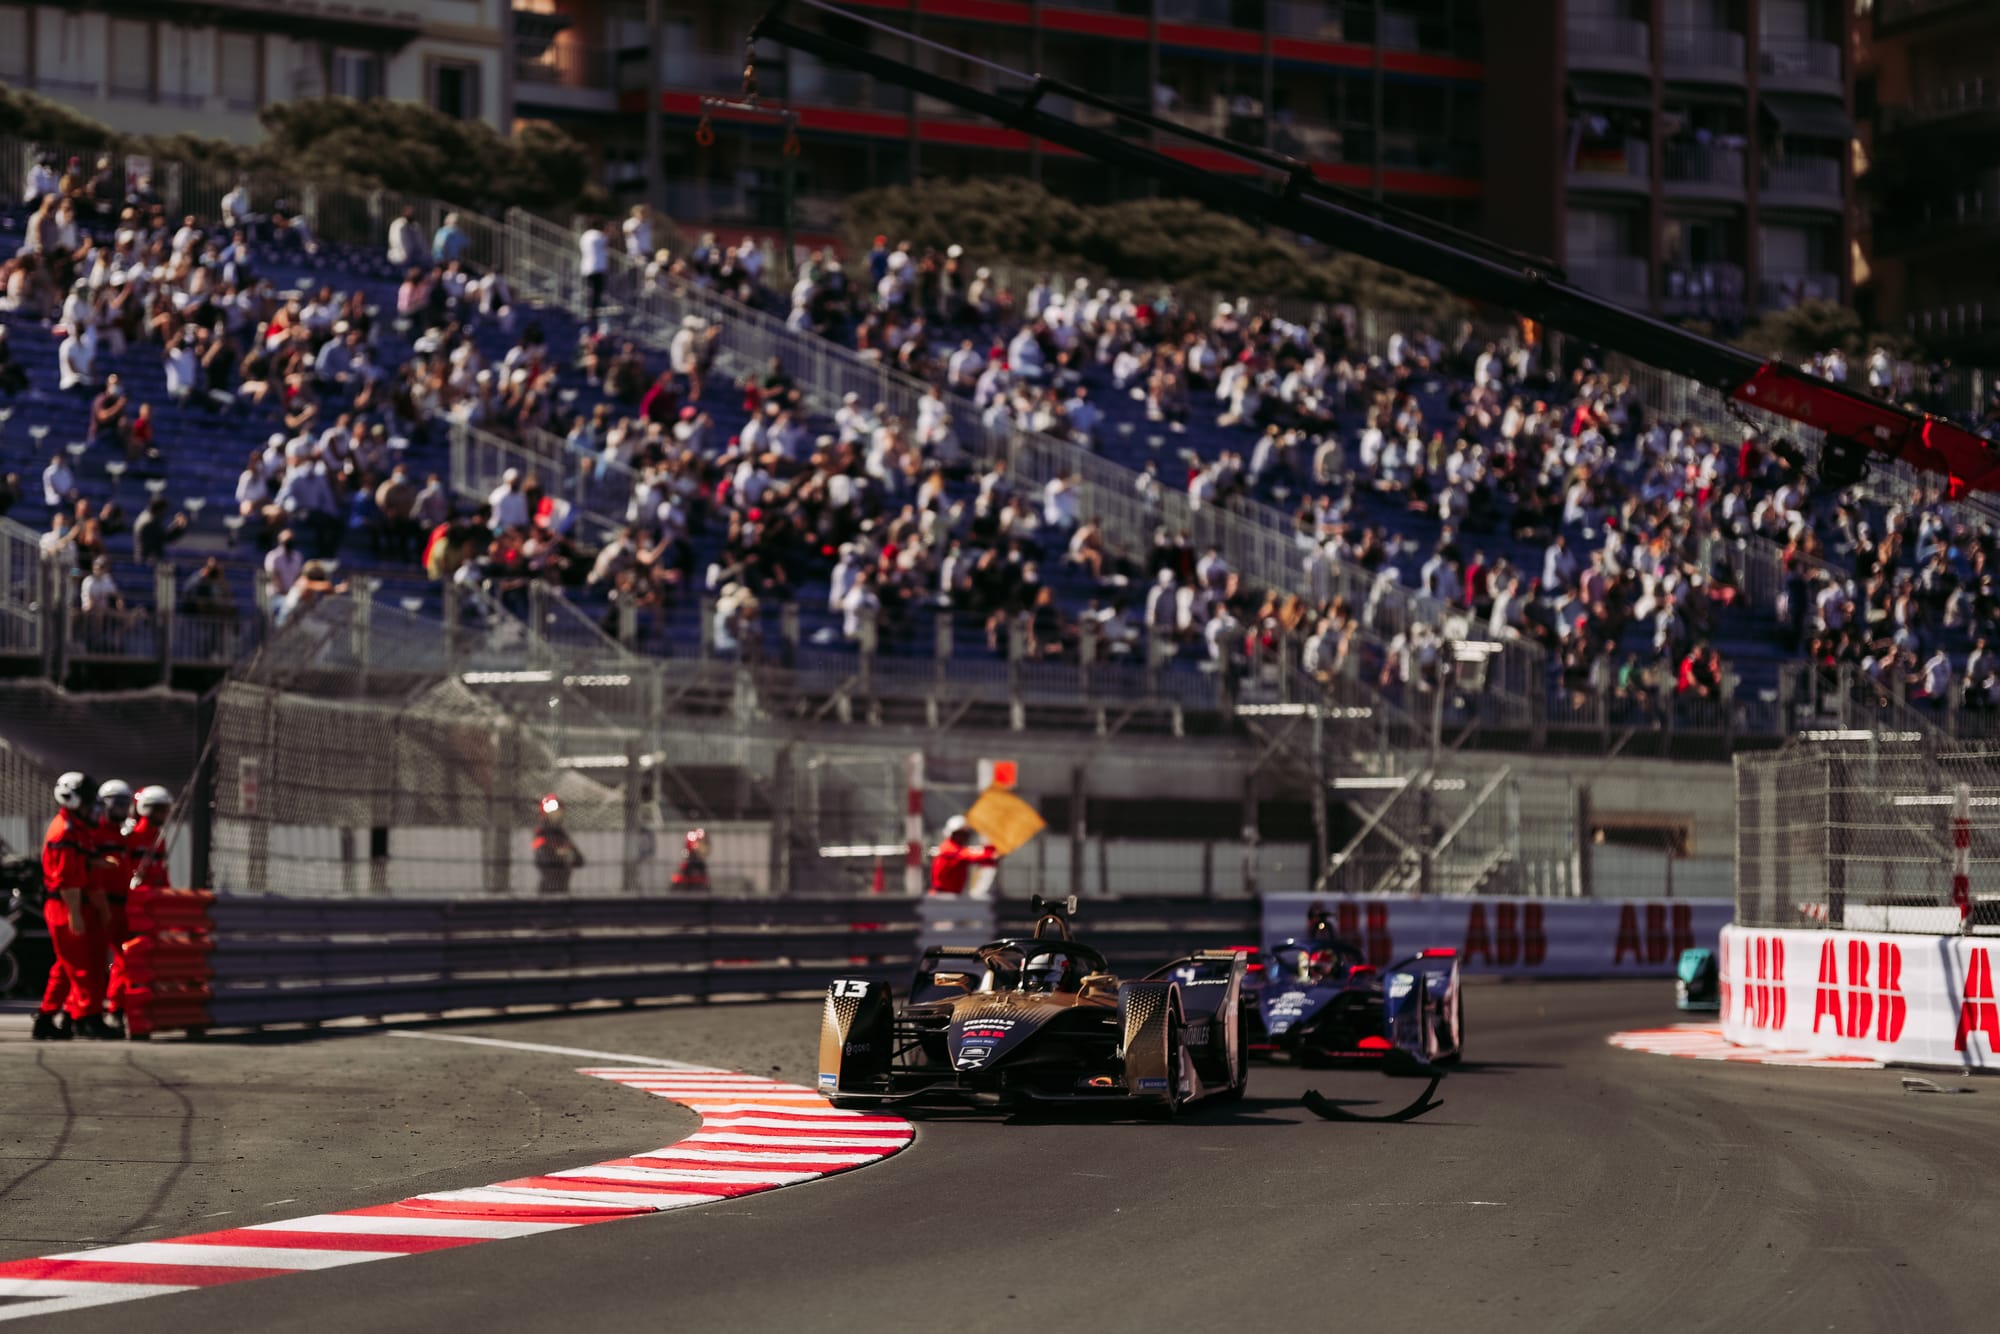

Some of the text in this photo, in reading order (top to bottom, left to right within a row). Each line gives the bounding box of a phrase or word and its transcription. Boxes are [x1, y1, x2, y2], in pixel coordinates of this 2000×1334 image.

[1308, 902, 1393, 966] BB
[1463, 902, 1548, 966] ABB
[1613, 902, 1697, 966] ABB
[832, 979, 871, 998] 13
[1743, 936, 1787, 1031] ABB
[1813, 938, 1907, 1044] ABB
[960, 1029, 1006, 1039] ABB
